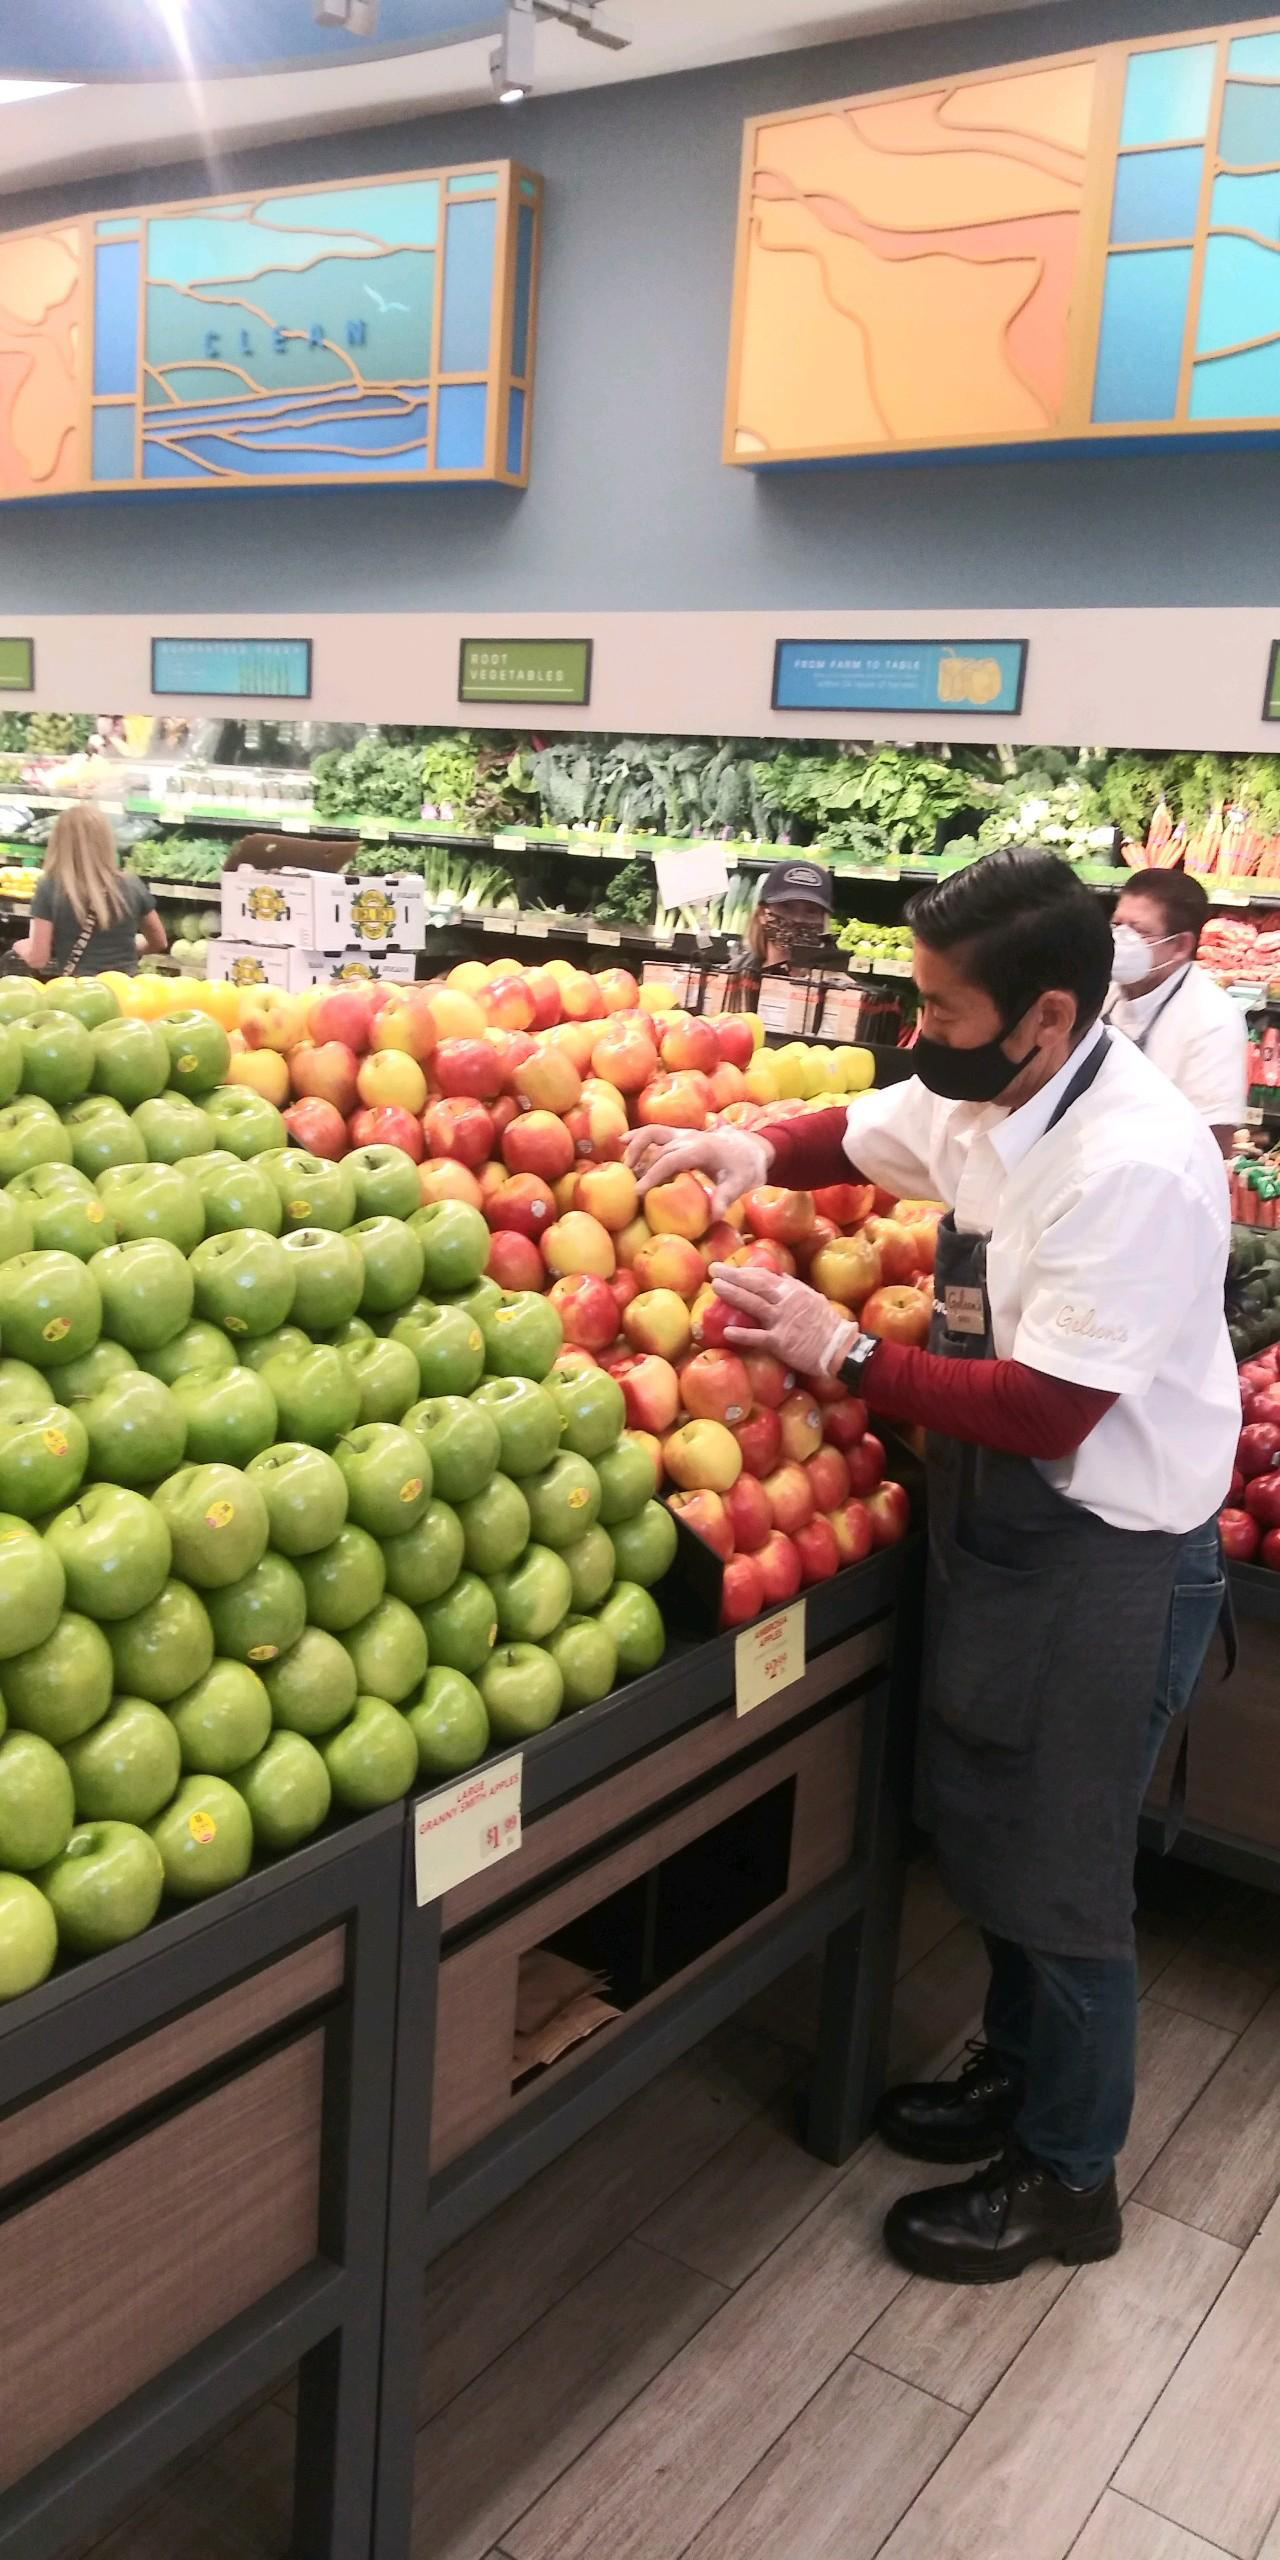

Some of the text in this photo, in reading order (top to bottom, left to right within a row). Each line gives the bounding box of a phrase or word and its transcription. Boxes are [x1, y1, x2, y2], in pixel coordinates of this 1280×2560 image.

[205, 320, 366, 358] CLEAN
[470, 653, 508, 665] ROOT
[793, 660, 921, 670] FROM FARM TO TABLE
[470, 669, 564, 682] VEGETABLES
[456, 1780, 485, 1803] LARGE
[419, 1773, 519, 1835] GRANNY SMITH APPLES
[486, 1825, 500, 1849] $1
